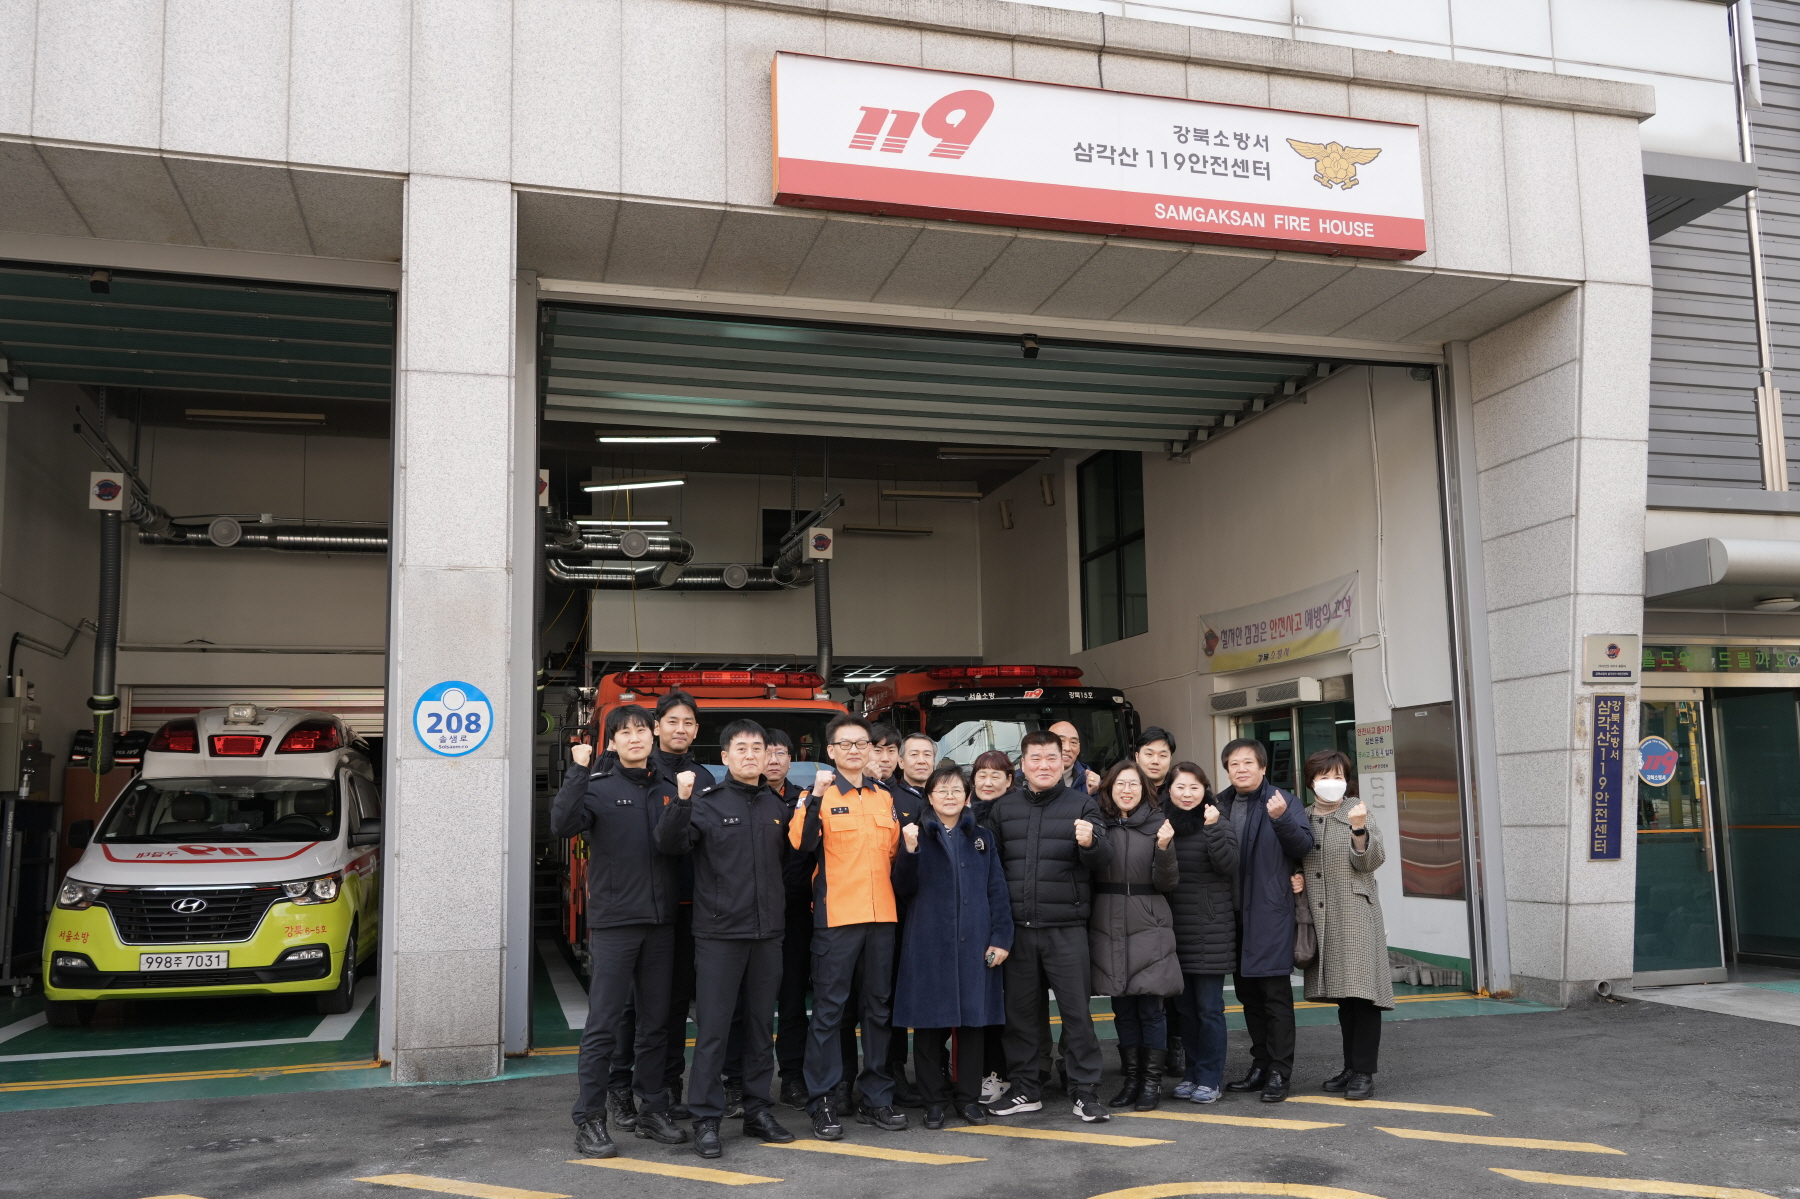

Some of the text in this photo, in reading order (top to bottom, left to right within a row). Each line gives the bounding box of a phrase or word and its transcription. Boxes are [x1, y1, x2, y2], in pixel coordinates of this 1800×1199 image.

[848, 89, 995, 160] 119
[1173, 125, 1270, 152] 강북소방서
[1073, 141, 1139, 168] 삼각산
[1154, 202, 1375, 238] SAMGAKSAN FIRE HOUSE
[1244, 621, 1268, 646] 점검은
[1269, 612, 1303, 640] 안전사고
[1304, 602, 1331, 630] 예방의
[1023, 688, 1044, 699] 119
[426, 712, 482, 734] 208
[1610, 700, 1622, 761] 강북소방서
[1643, 750, 1679, 775] 119
[59, 930, 90, 944] 서울소방
[145, 954, 220, 969] 998주 7031
